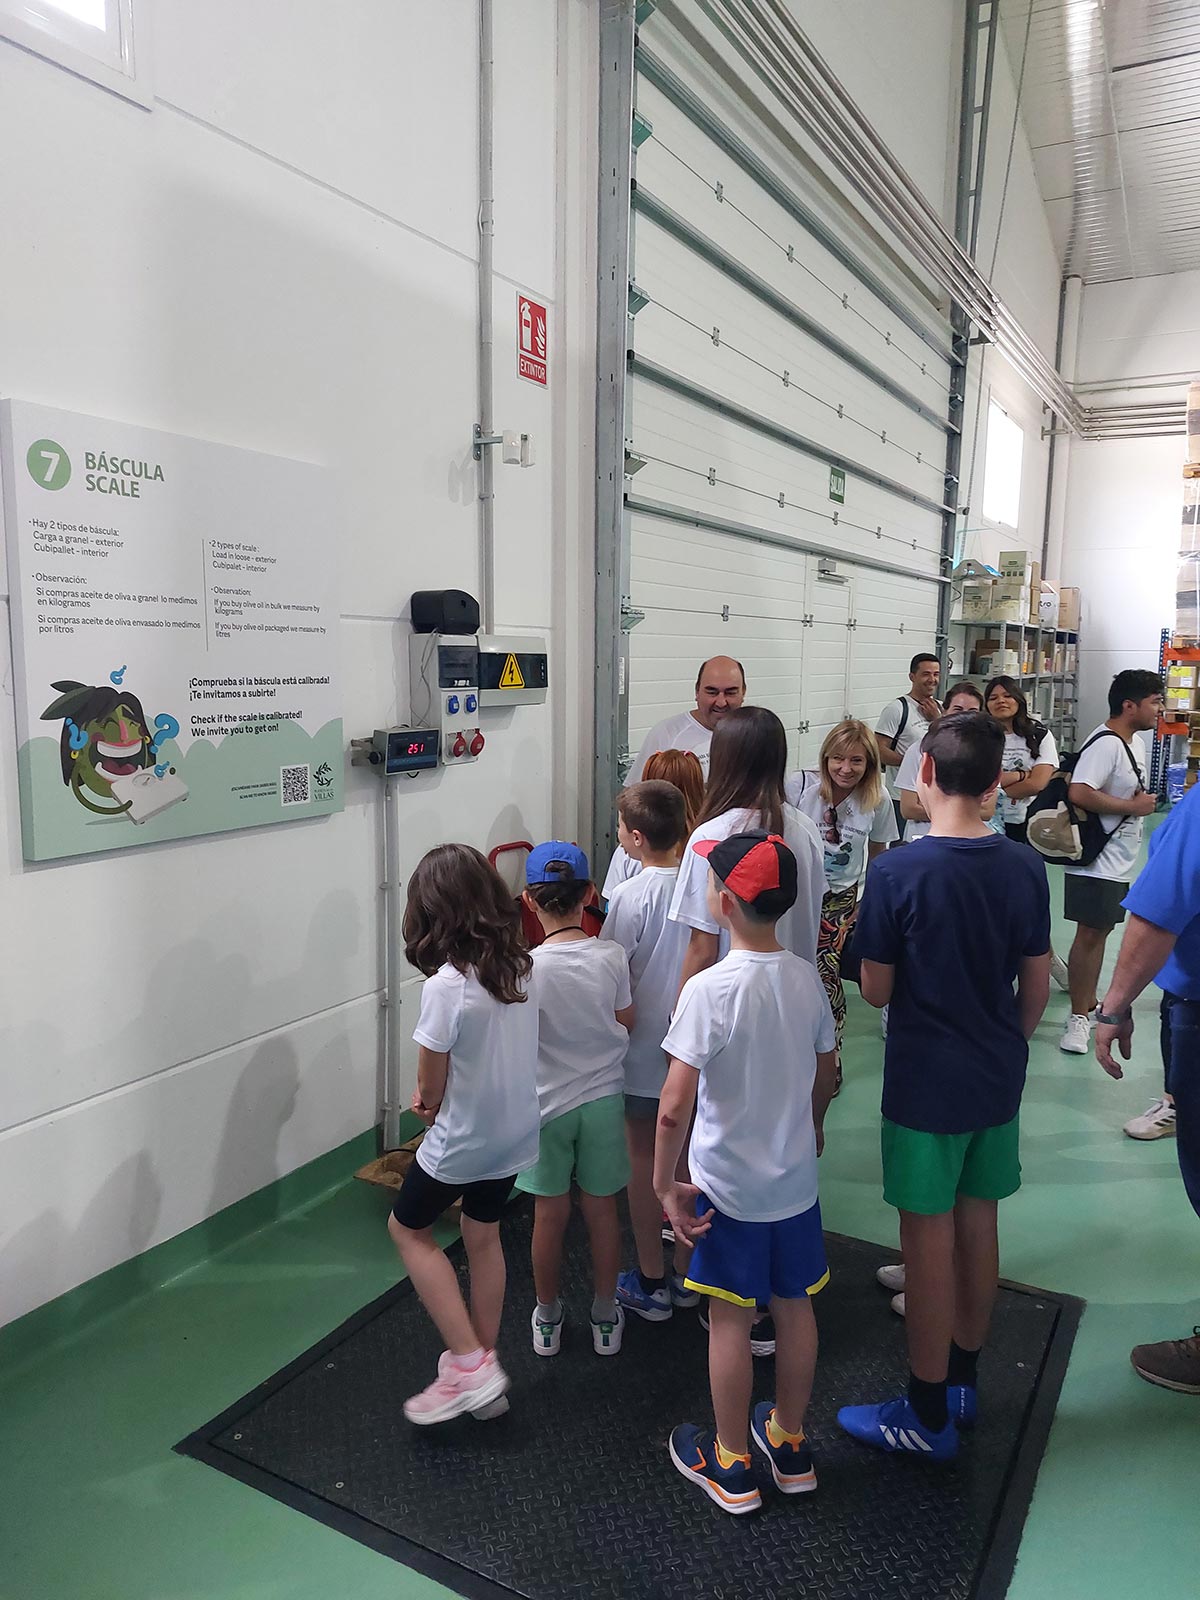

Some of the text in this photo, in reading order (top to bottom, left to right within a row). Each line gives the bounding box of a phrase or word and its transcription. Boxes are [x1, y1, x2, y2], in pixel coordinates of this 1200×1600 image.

[521, 359, 545, 380] EXTINTOR
[40, 451, 60, 482] 7
[85, 451, 165, 482] BÁSCULA
[86, 474, 140, 498] SCALE
[50, 520, 55, 529] 2
[57, 522, 77, 532] tipos
[78, 524, 88, 533] de
[90, 526, 120, 536] báscula:
[33, 531, 57, 542] Carga
[65, 536, 88, 544] granel
[96, 540, 124, 548] exterior
[217, 541, 234, 550] types
[34, 543, 75, 554] Cubipallet
[81, 548, 109, 558] interior
[212, 551, 227, 559] Load
[235, 553, 250, 561] loose
[213, 561, 242, 570] Cubipalet
[246, 564, 267, 572] interior
[36, 587, 44, 596] Si
[46, 590, 79, 598] compras
[81, 591, 103, 599] aceite
[104, 592, 113, 600] de
[115, 592, 131, 600] oliva
[138, 595, 158, 603] granel
[169, 596, 197, 604] medimos
[49, 598, 91, 608] kilogramos
[215, 607, 243, 616] kilograms
[38, 615, 46, 623] Si
[47, 617, 80, 625] compras
[82, 617, 103, 625] aceite
[105, 618, 114, 626] de
[115, 618, 131, 626] oliva
[132, 620, 164, 628] envasado
[165, 620, 171, 628] lo
[39, 625, 74, 634] por litros
[220, 623, 231, 631] you
[265, 625, 289, 633] packaged
[320, 626, 326, 634] by
[189, 678, 237, 688] ¡Comprueba
[239, 678, 245, 686] si
[246, 677, 252, 685] la
[254, 677, 280, 685] báscula
[298, 676, 330, 684] calibrada!
[190, 691, 201, 701] ¡Te
[203, 690, 241, 699] invitamos
[248, 689, 276, 697] subirte!
[191, 711, 302, 724] Check if the scale is calibrated!
[191, 728, 205, 737] We
[207, 727, 228, 736] invite
[230, 727, 243, 736] you
[255, 725, 267, 734] get
[268, 723, 279, 732] on!
[408, 744, 424, 754] 251
